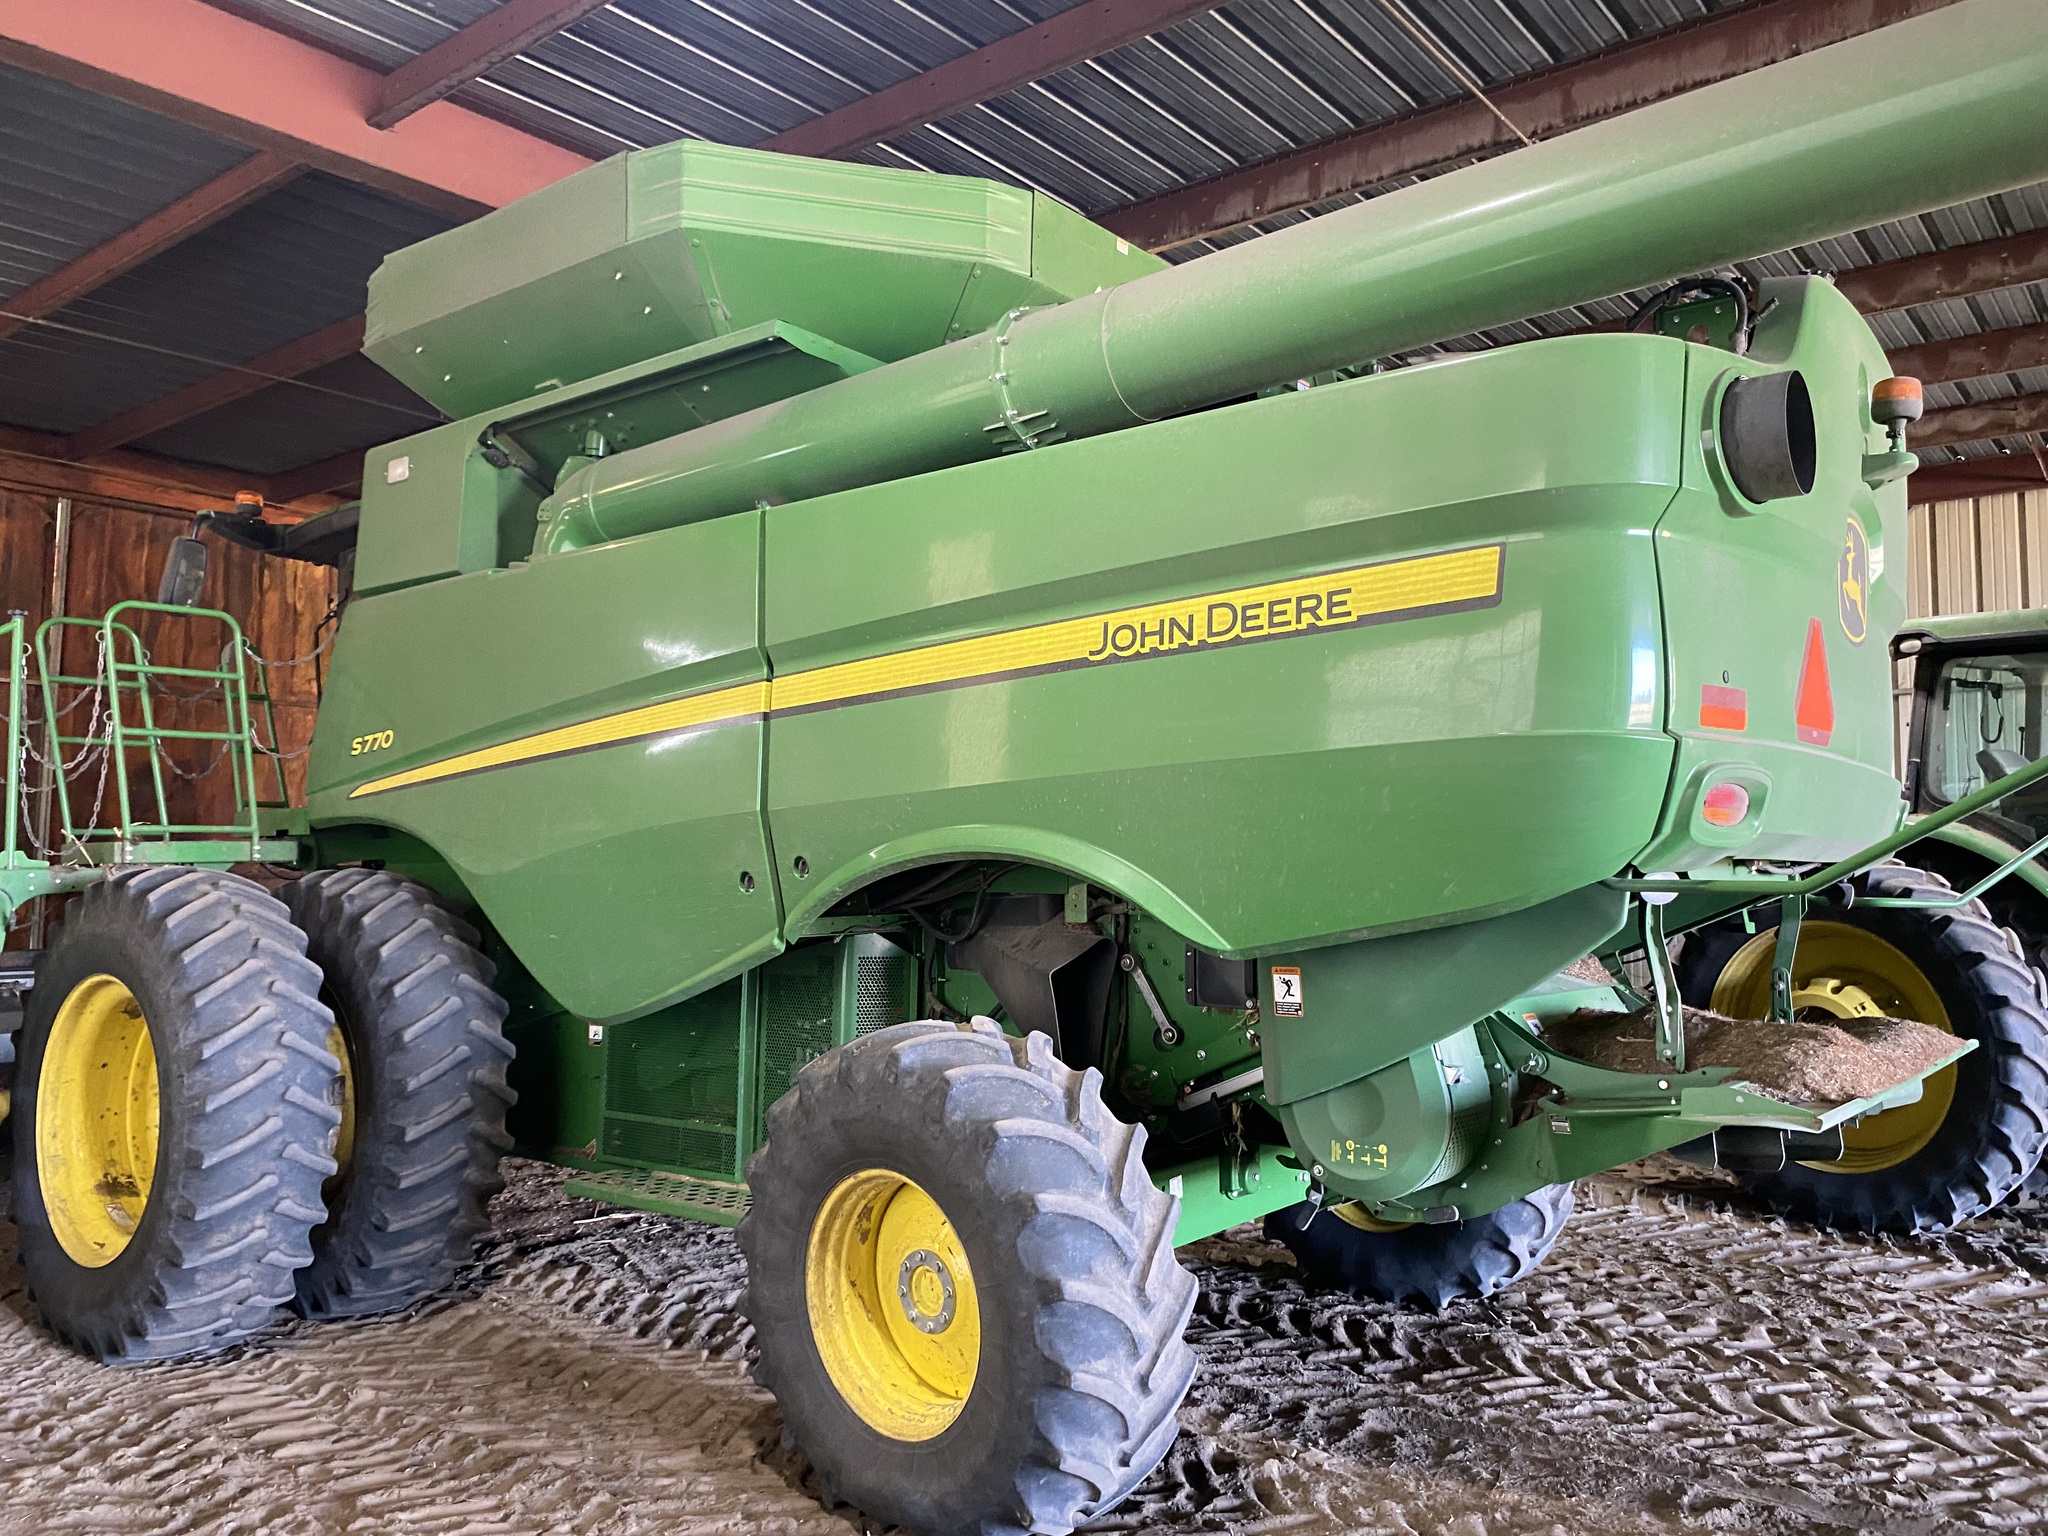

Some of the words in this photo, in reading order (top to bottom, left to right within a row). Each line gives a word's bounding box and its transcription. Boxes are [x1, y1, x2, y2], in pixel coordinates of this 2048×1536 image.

[1088, 614, 1194, 656] JOHN
[1206, 587, 1353, 638] DEERE
[350, 729, 394, 756] S770
